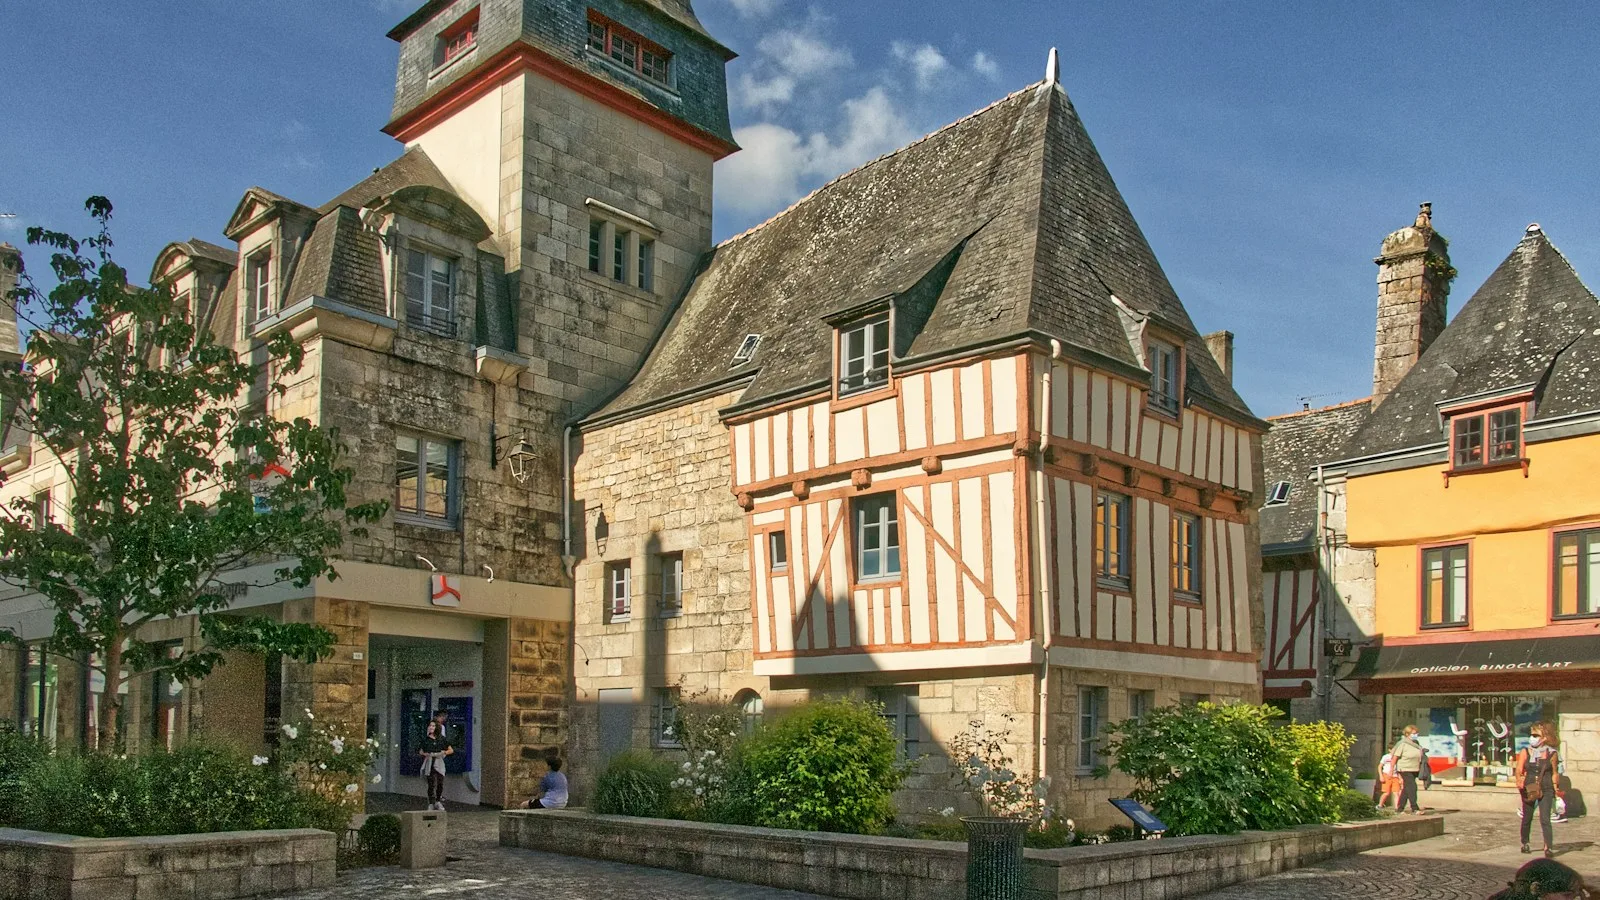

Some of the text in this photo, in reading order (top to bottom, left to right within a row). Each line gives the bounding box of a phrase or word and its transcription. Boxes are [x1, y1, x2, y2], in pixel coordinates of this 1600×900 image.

[1411, 662, 1572, 674] opticien BINOCL'ART
[1458, 696, 1505, 705] opticien
